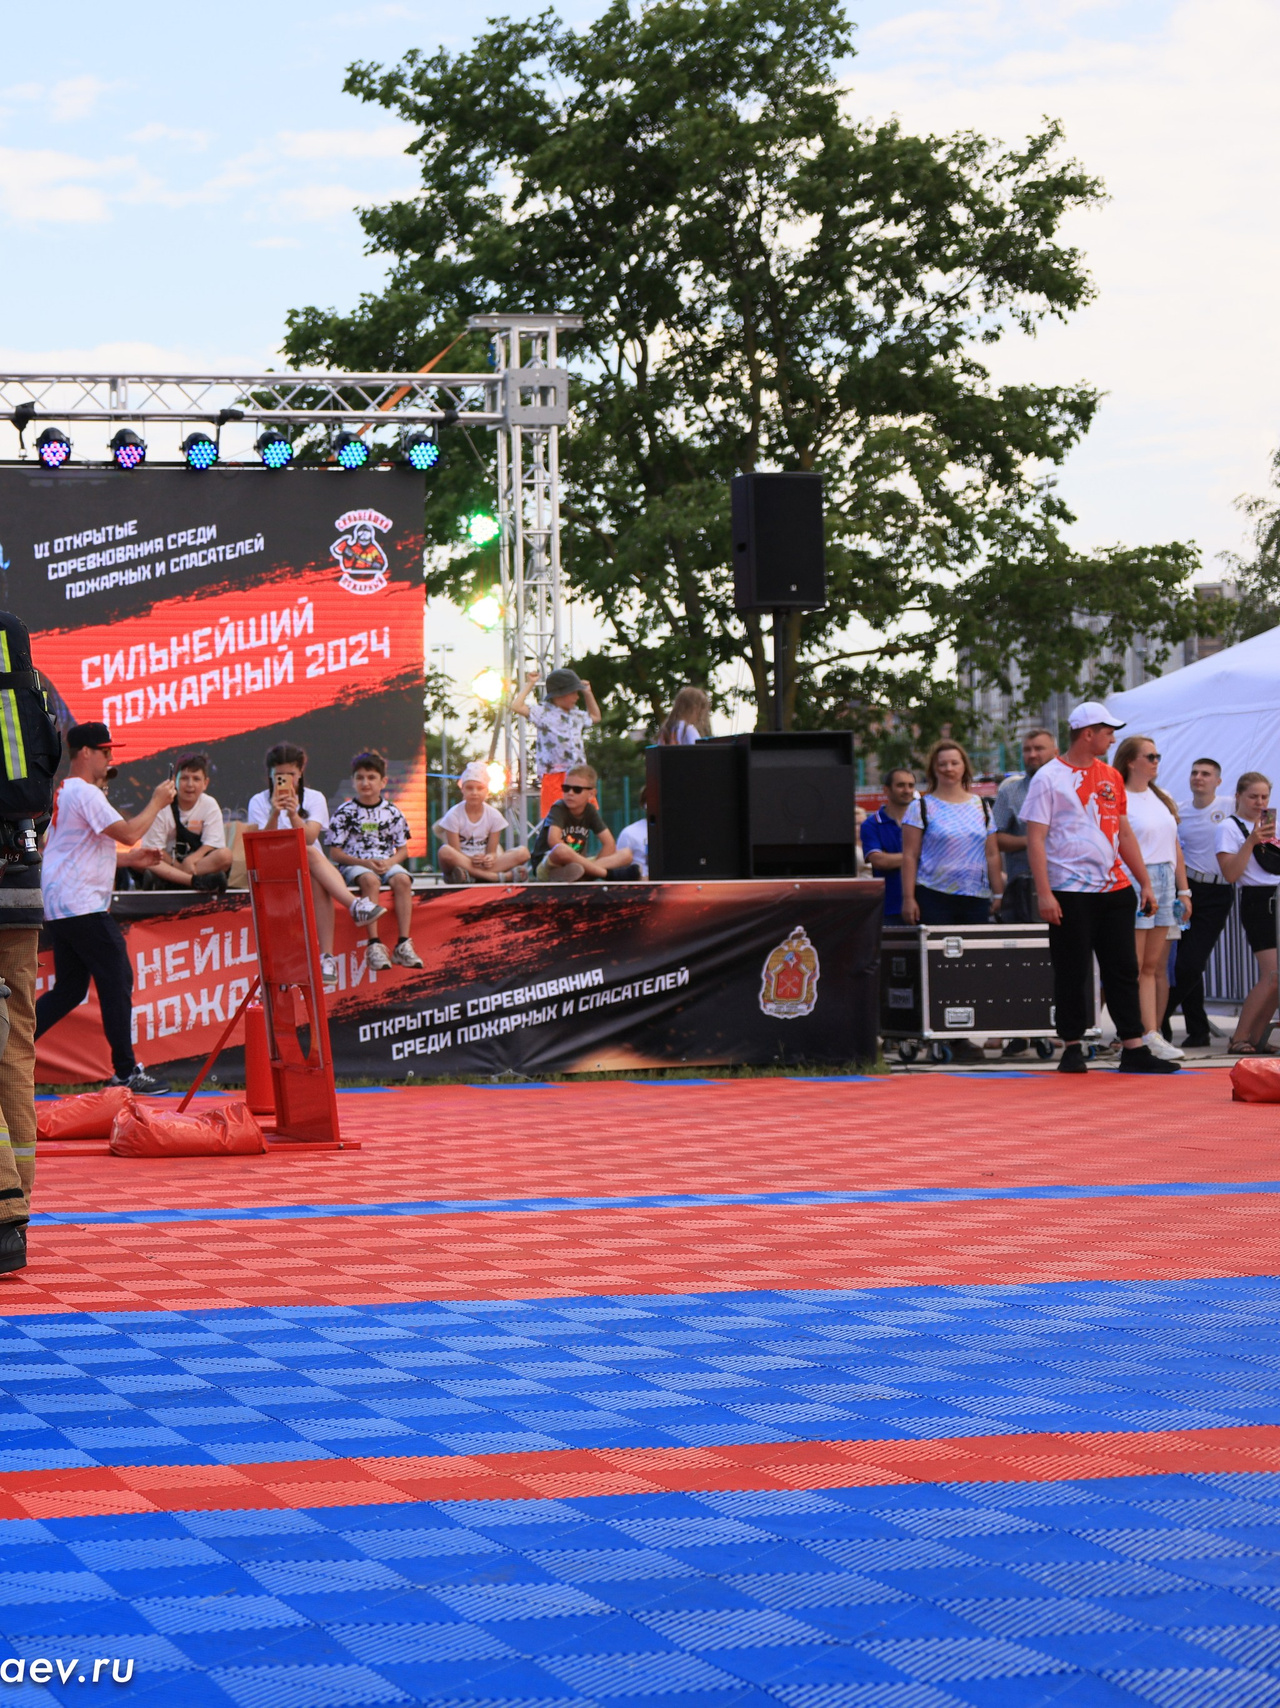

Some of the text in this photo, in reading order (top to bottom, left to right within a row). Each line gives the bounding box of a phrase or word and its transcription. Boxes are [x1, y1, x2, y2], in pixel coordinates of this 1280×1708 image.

[47, 524, 217, 580] СОРЕВНОВАНИЯ СРЕДИ
[53, 519, 138, 554] ОТКРЫТЫЕ
[65, 533, 264, 600] ПОЖАРНЫХ И СПАСАТЕЛЕЙ
[81, 596, 314, 690] СИЛЬНЕЙШИЙ
[102, 626, 390, 733] ПОЖАРНЫЙ 2024
[359, 968, 604, 1043] ОТКРЫТЫЕ СОРЕВНОВАНИЯ
[392, 966, 690, 1061] СРЕДИ ПОЖАРНЫХ И СПАСАТЕЛЕЙ
